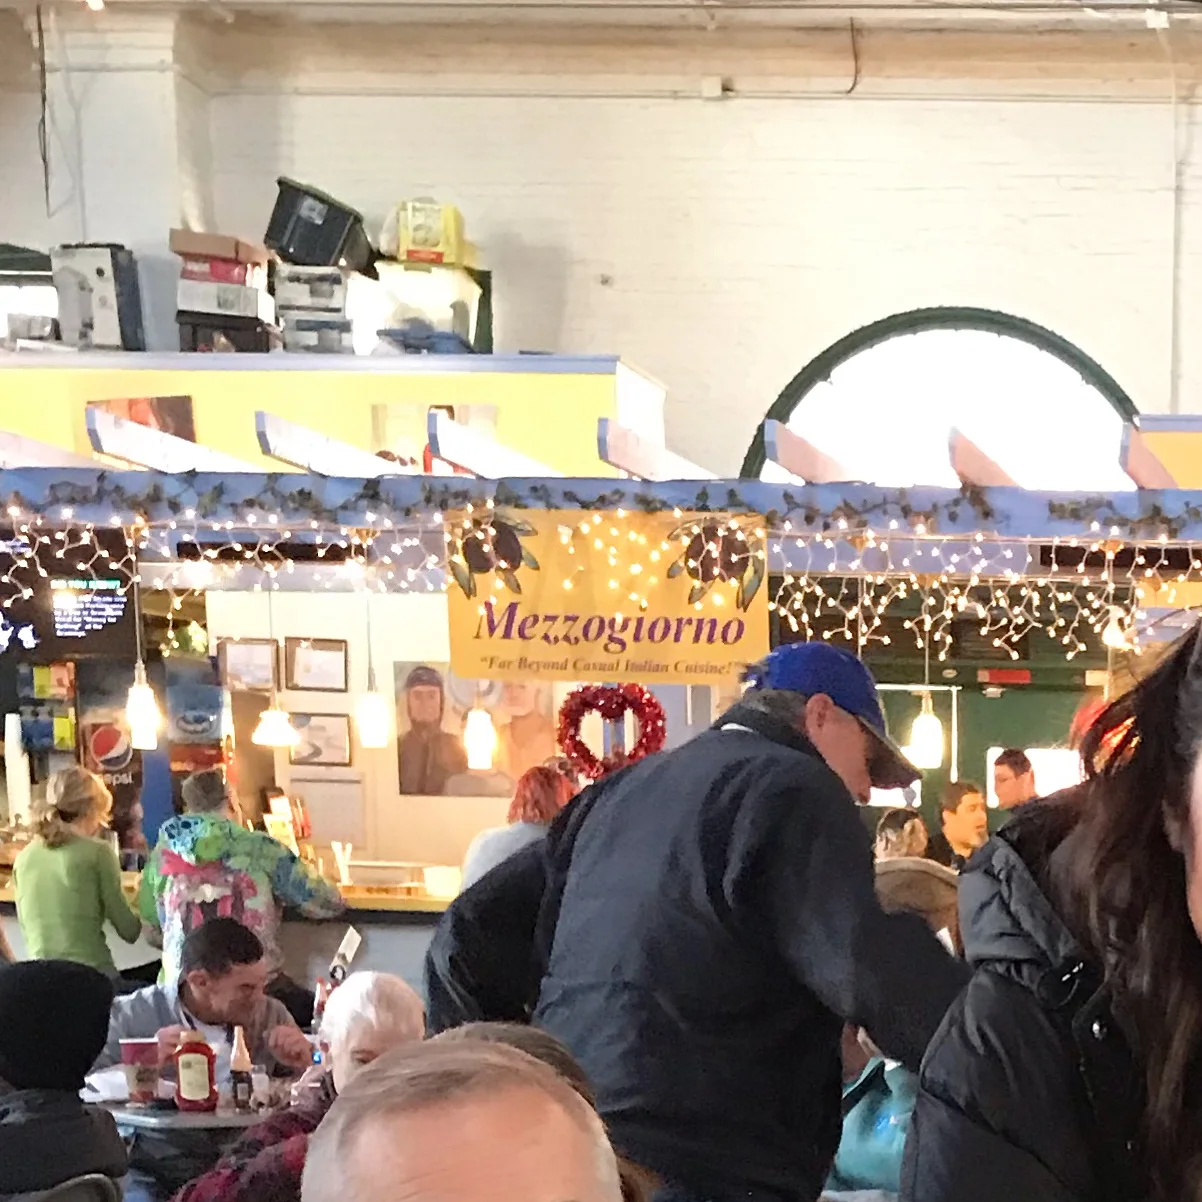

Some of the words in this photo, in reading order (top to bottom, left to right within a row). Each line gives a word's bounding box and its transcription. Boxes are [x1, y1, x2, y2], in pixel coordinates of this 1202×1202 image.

[473, 600, 746, 655] Mezzogiorno
[517, 656, 568, 674] Beyond
[572, 658, 620, 673] Casual
[624, 658, 670, 674] Italian
